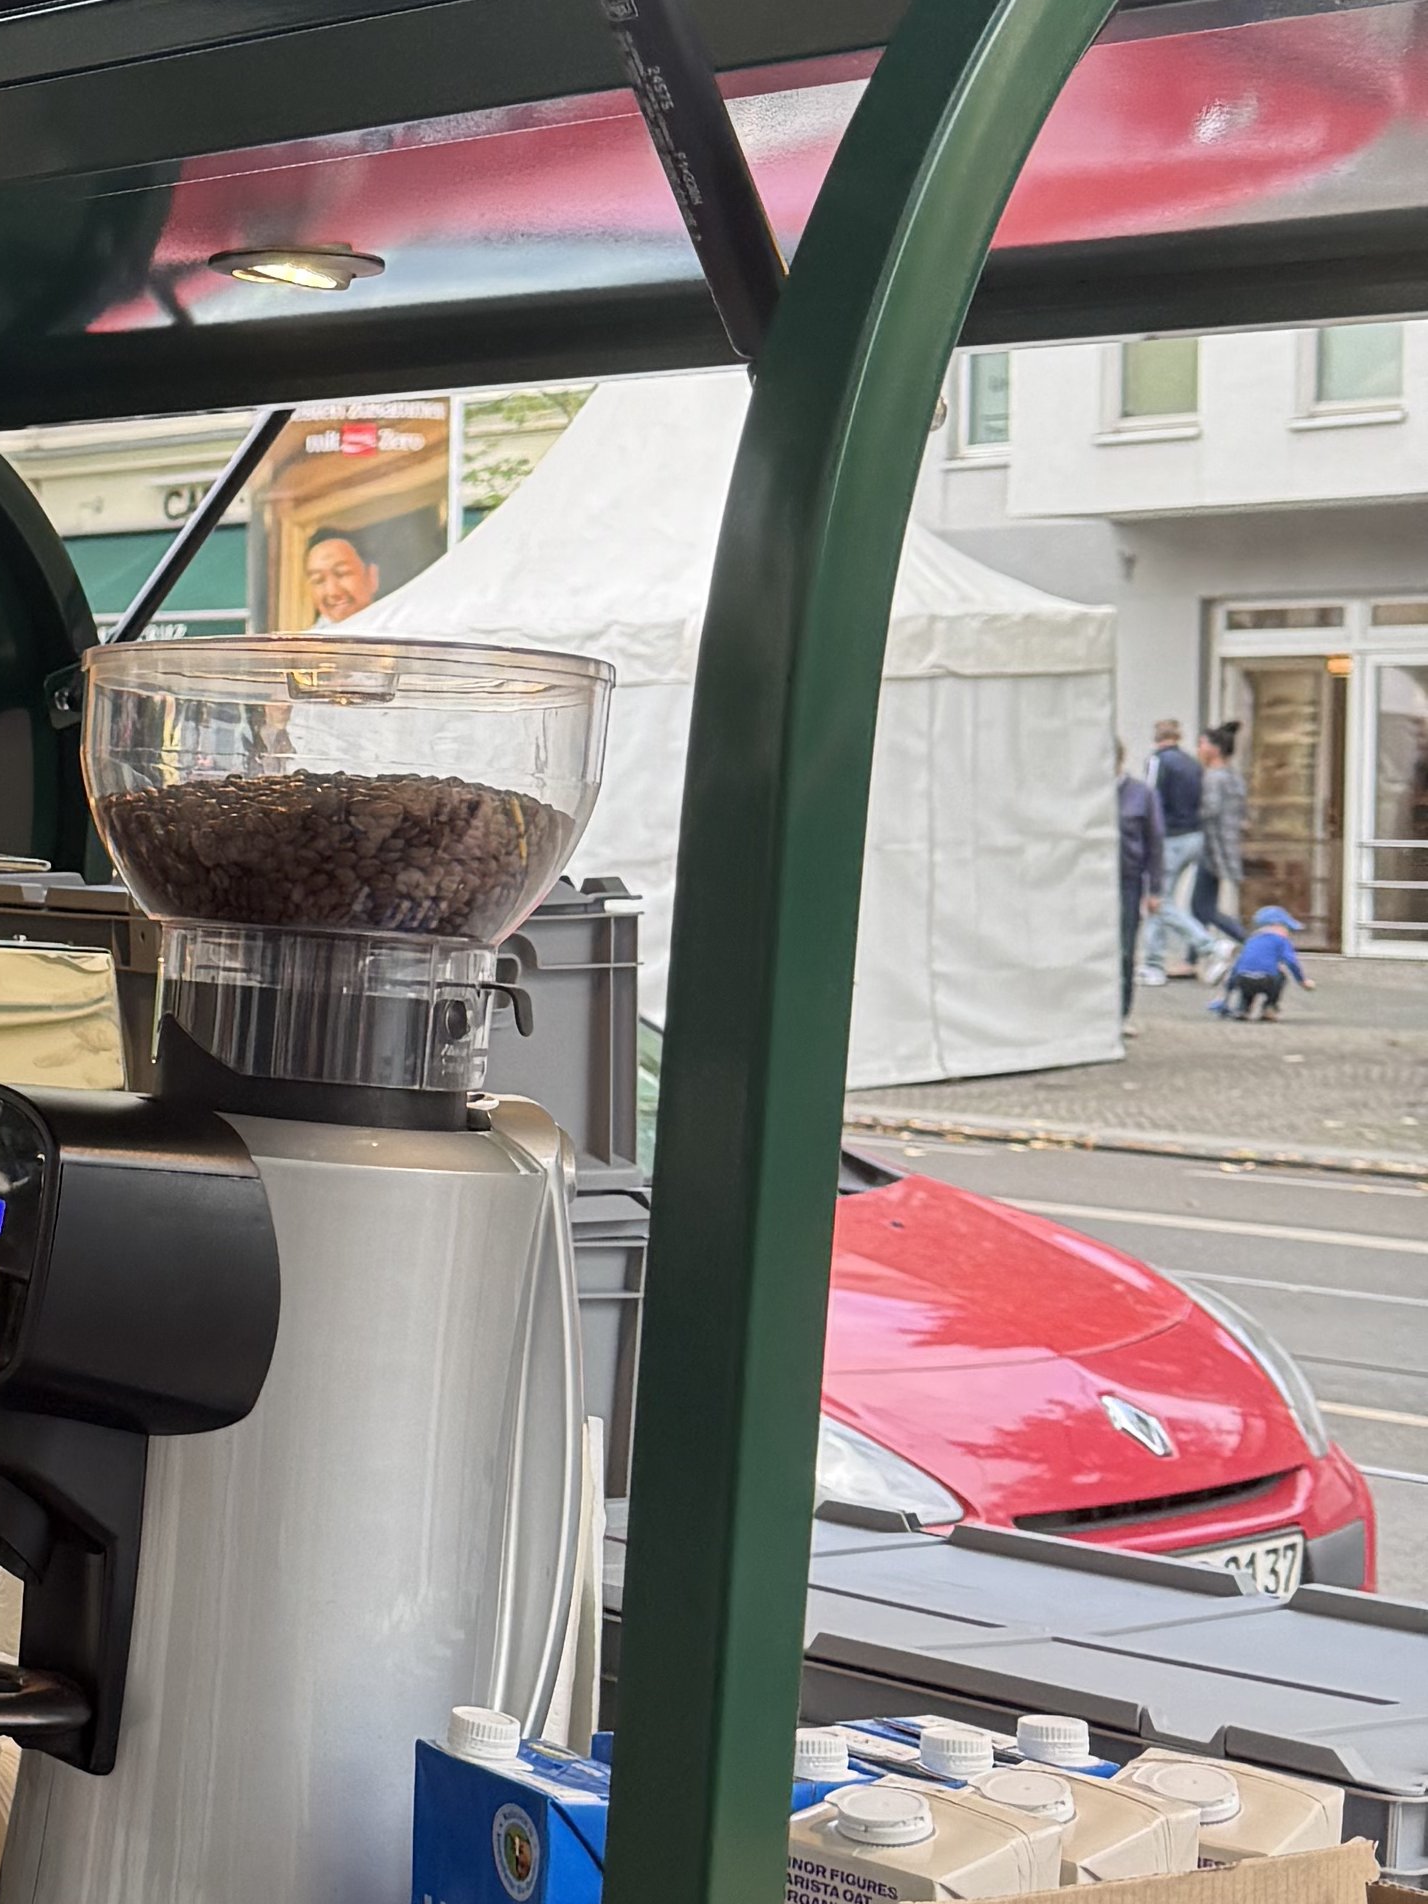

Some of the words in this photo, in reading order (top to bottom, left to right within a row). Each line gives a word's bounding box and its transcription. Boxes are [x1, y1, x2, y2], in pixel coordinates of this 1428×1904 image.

[786, 1872, 839, 1899] ARISTA
[788, 1856, 827, 1879] INOR
[830, 1868, 898, 1900] FIGURES
